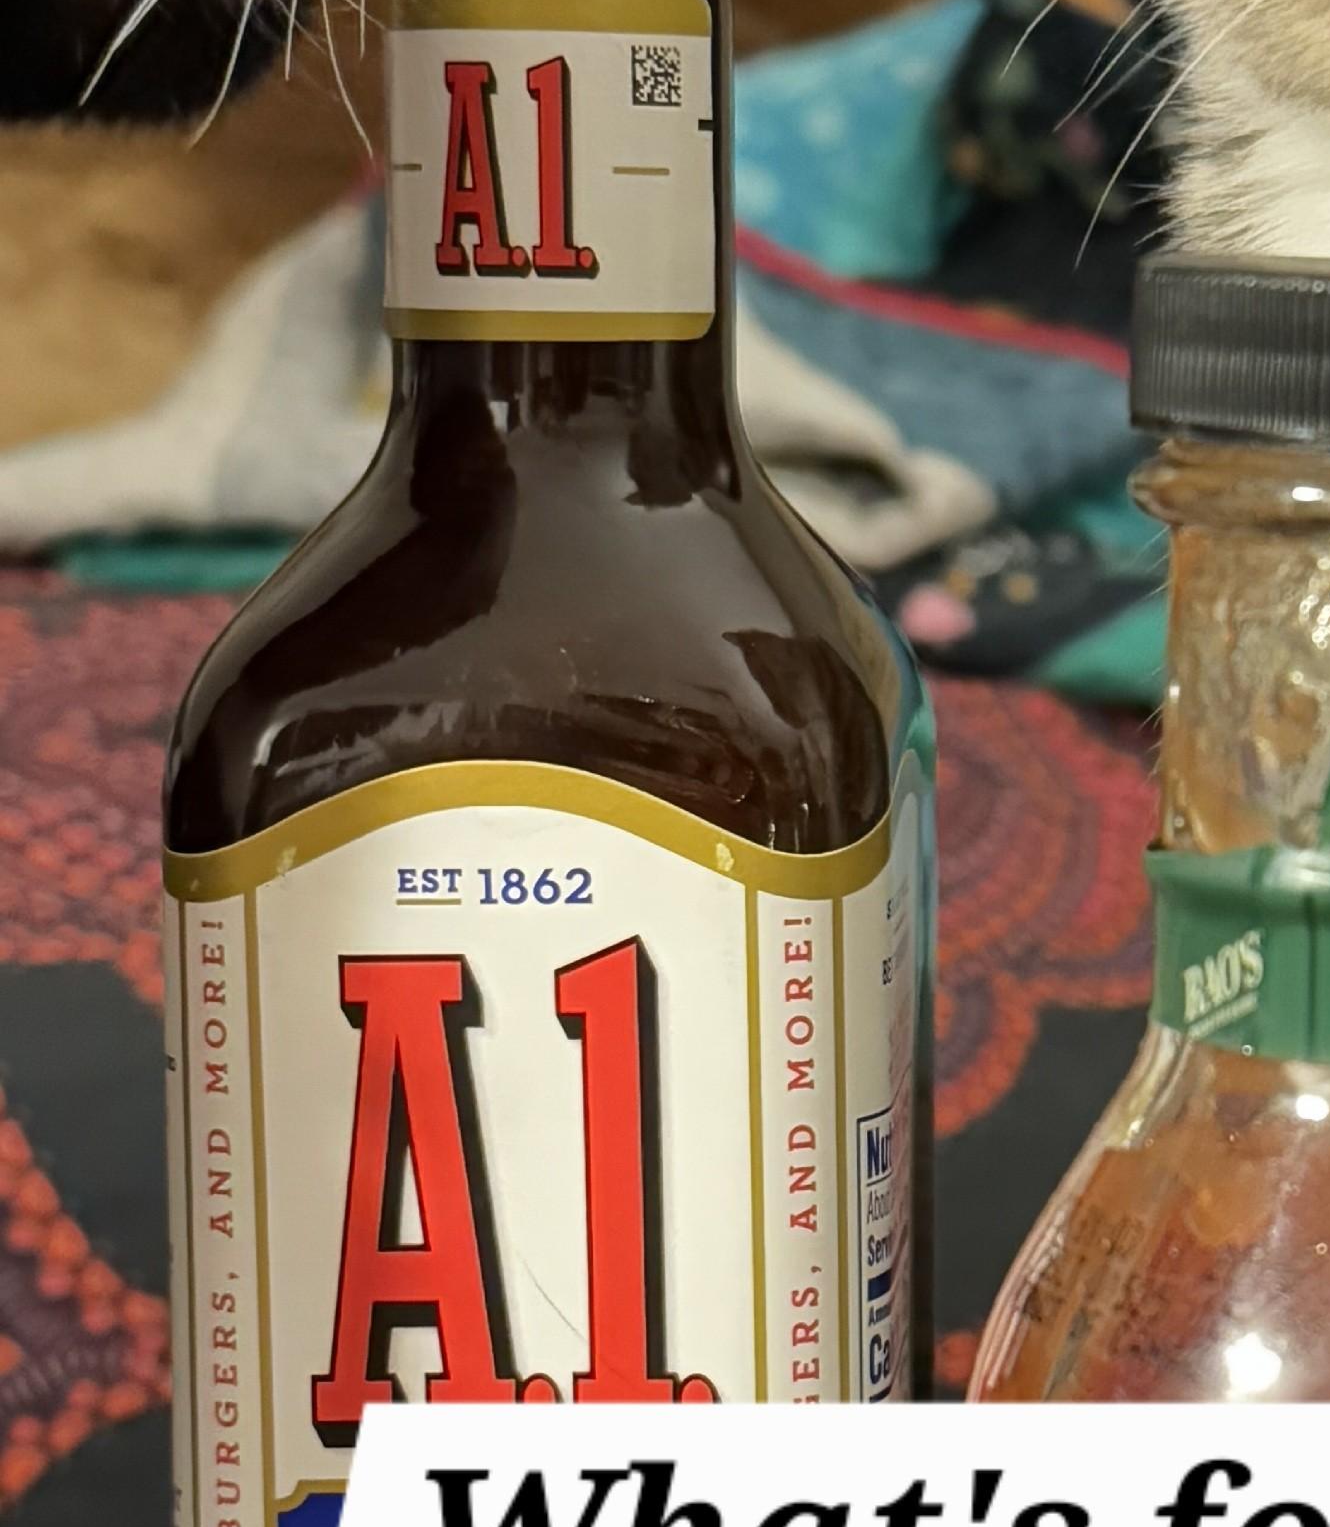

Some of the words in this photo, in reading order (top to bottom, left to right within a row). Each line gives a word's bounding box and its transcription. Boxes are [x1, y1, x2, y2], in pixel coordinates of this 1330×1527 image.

[398, 868, 461, 893] EST
[478, 868, 594, 906] 1862
[201, 920, 230, 1095] MORE!
[784, 917, 814, 1090] MORE!
[207, 1127, 234, 1239] AND
[787, 1124, 818, 1232] AND
